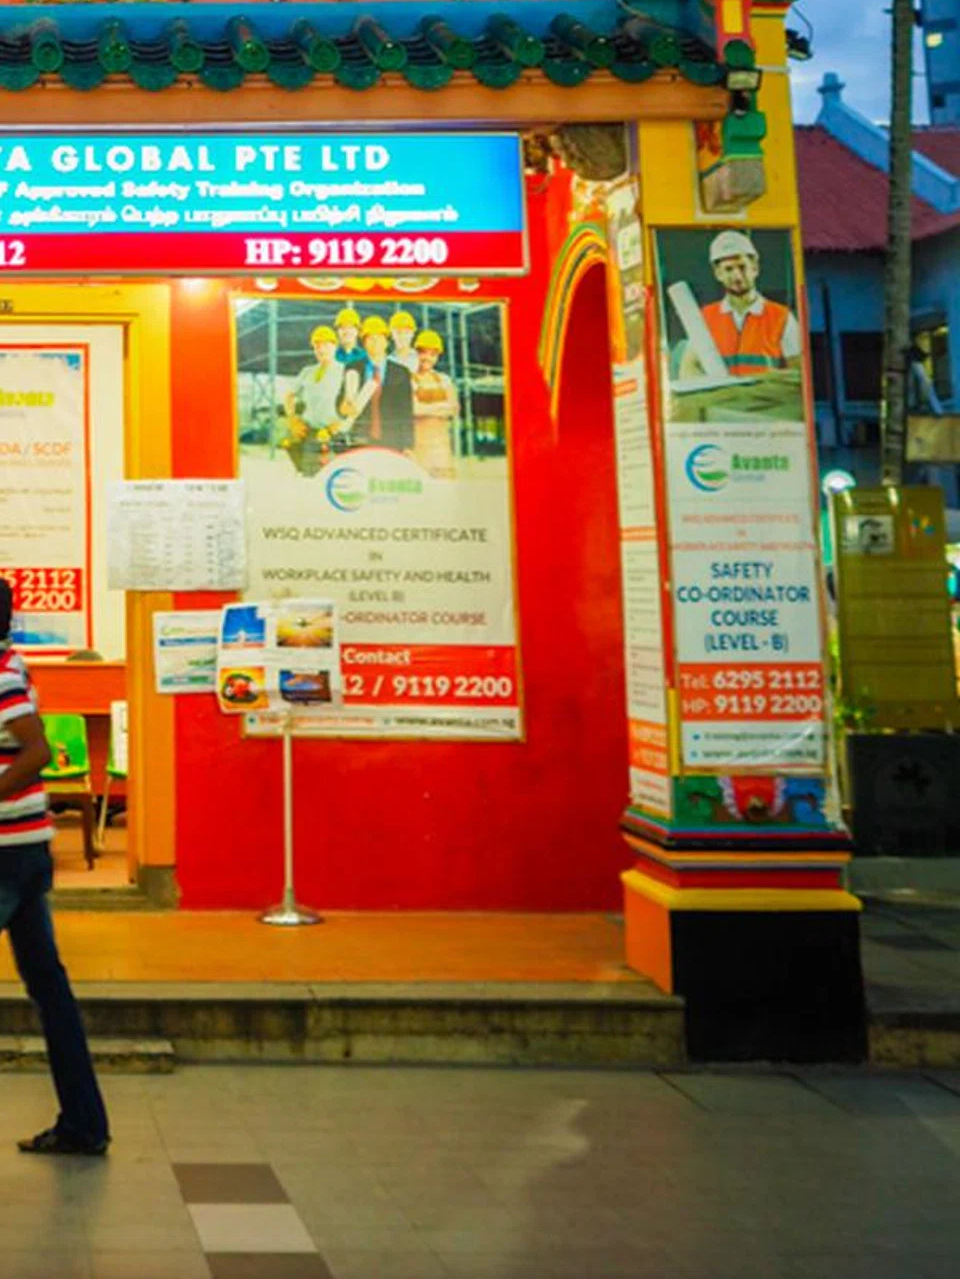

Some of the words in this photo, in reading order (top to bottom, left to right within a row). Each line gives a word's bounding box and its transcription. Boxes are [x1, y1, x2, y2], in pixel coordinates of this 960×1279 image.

[51, 144, 216, 172] GLOBAL
[235, 144, 303, 172] PTE
[321, 144, 391, 172] LTD
[15, 181, 116, 200] Approved
[121, 181, 190, 201] Safety
[195, 180, 284, 201] Training
[244, 238, 303, 265] HP:
[309, 238, 375, 265] 9119
[380, 238, 449, 265] 2200
[32, 441, 72, 456] SCDF
[262, 527, 299, 542] WSQ
[302, 527, 388, 542] ADVANCED
[391, 527, 488, 543] CERTIFICATE
[20, 570, 76, 589] 2112
[262, 570, 348, 583] WORKPLACE
[350, 570, 402, 583] SAFETY
[403, 570, 436, 583] AND
[437, 570, 491, 584] HEALTH
[710, 562, 774, 579] SAFETY
[20, 590, 76, 609] 2200
[676, 585, 811, 603] CO-ORDINATOR
[430, 610, 486, 626] COURSE
[710, 609, 779, 627] COURSE
[703, 633, 759, 653] (LEVEL
[343, 647, 412, 665] Contact
[371, 675, 386, 697] /
[392, 675, 451, 697] 9119
[454, 675, 513, 698] 2200
[712, 670, 766, 689] 6295
[768, 670, 821, 689] 2112
[714, 694, 767, 714] 9119
[770, 694, 823, 714] 2200
